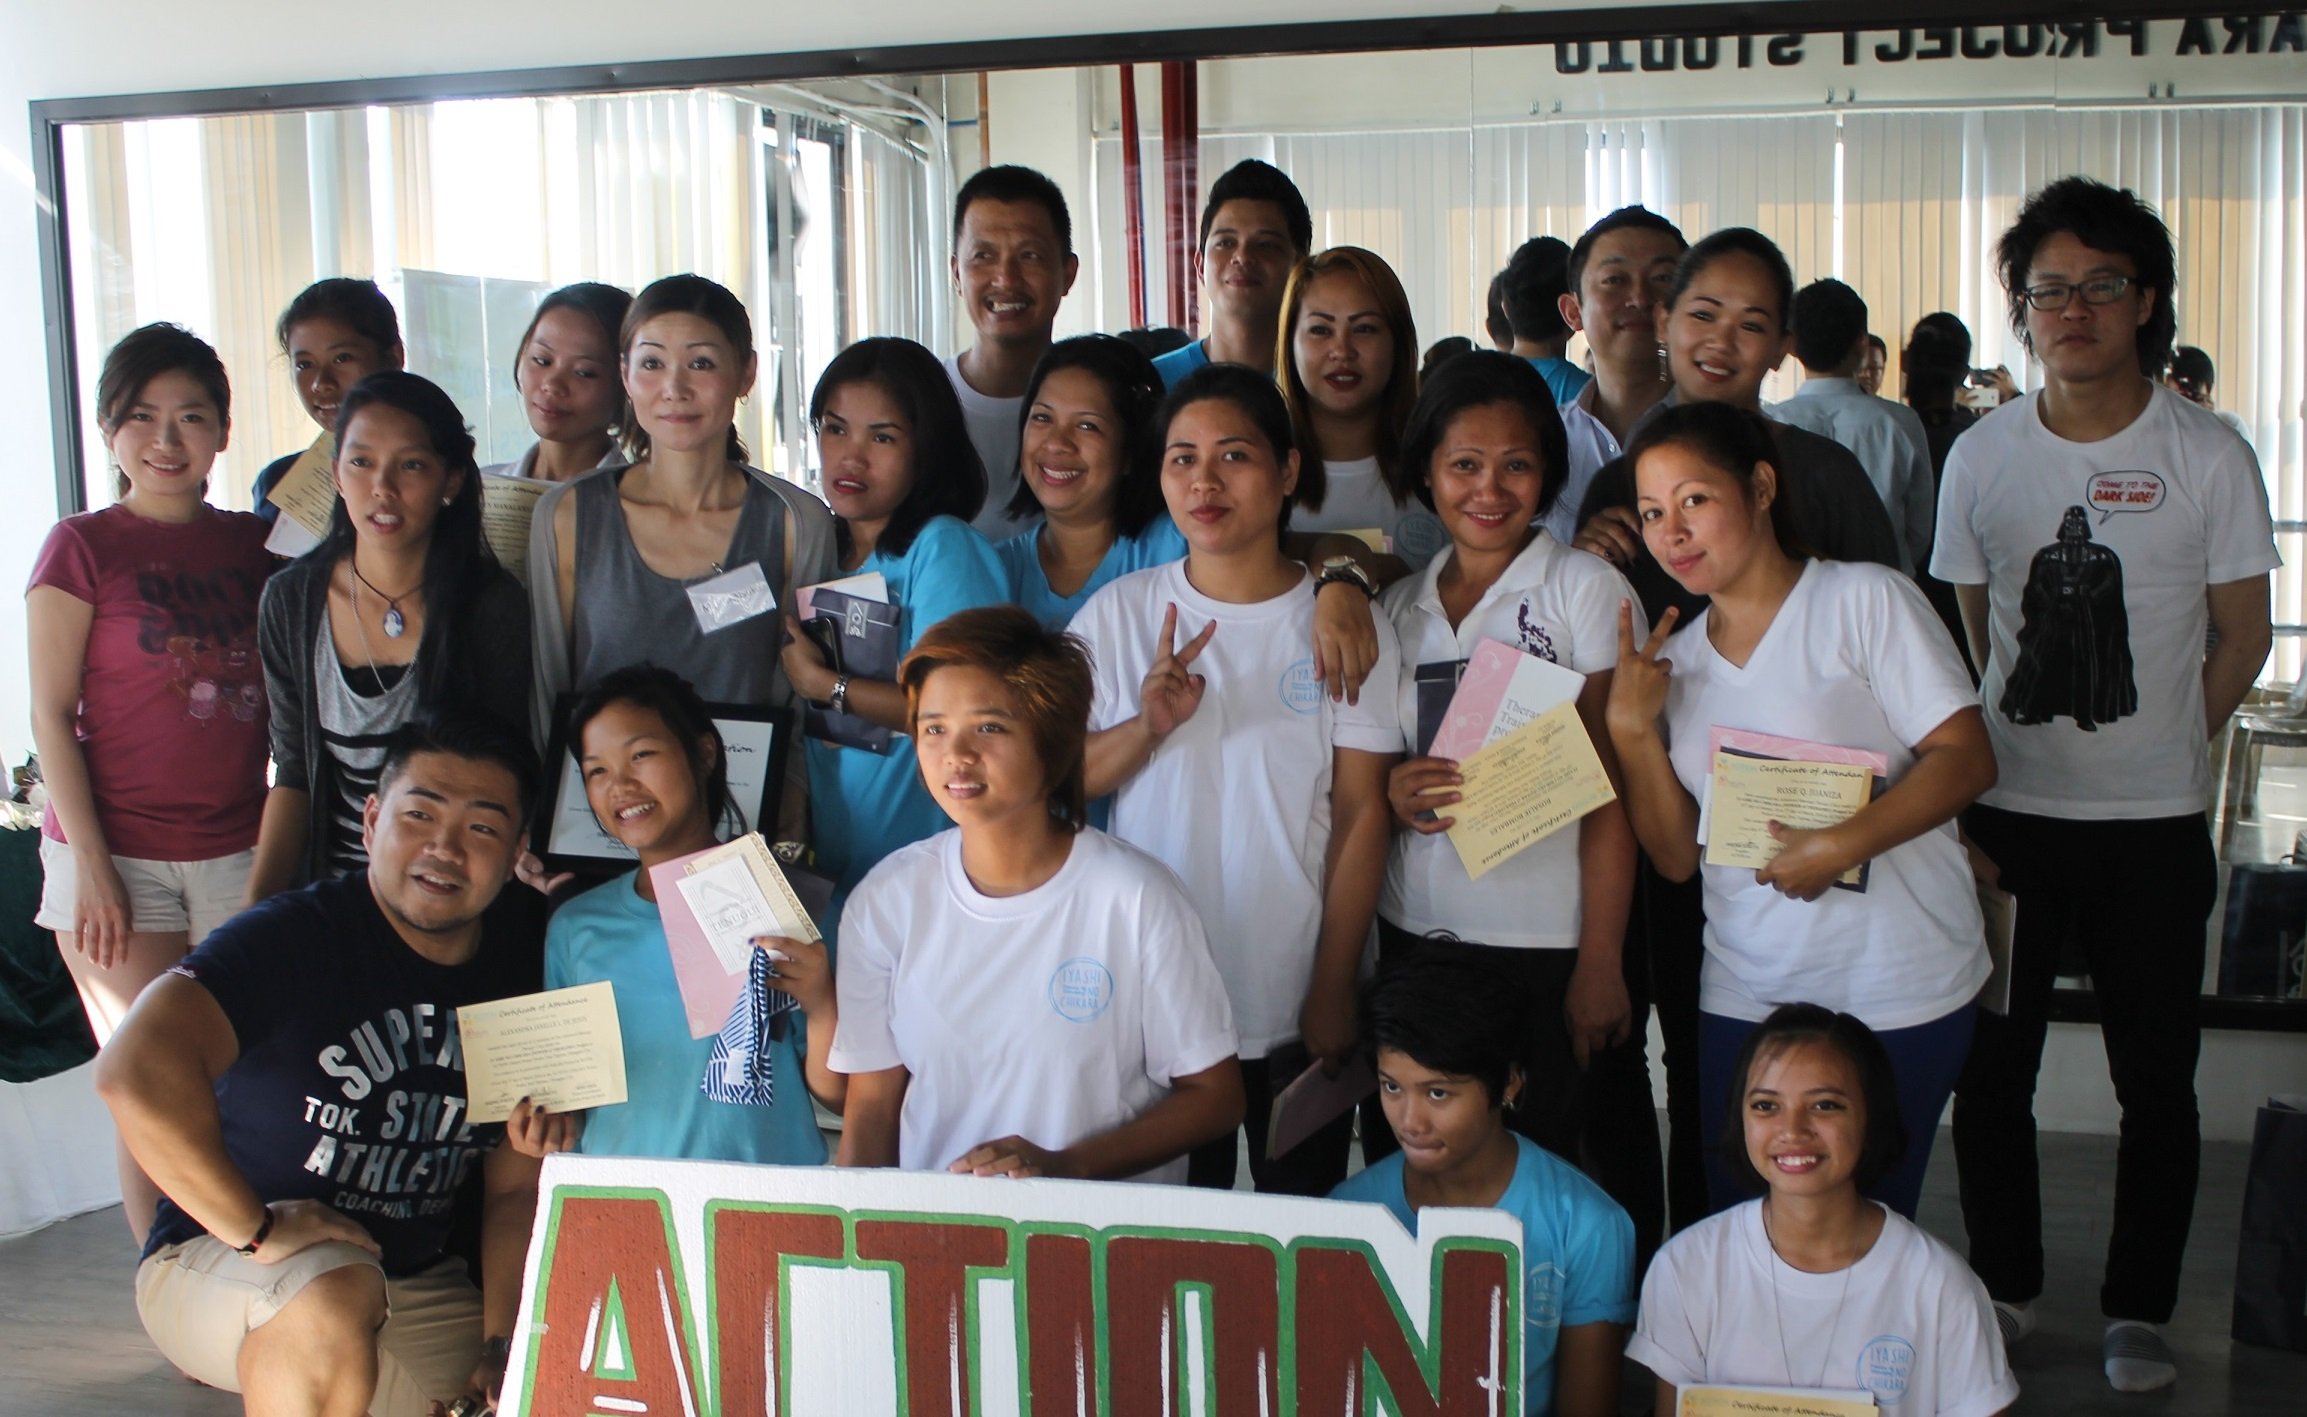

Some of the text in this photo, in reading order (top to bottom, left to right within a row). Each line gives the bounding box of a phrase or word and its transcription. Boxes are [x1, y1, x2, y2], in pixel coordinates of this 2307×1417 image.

[2094, 489, 2156, 503] DARK SIDE!
[1759, 765, 1807, 777] Certificate
[1810, 767, 1821, 777] of
[1062, 968, 1101, 984] IYASHI
[304, 1095, 361, 1136] TOK.
[520, 1185, 1520, 1417] ACTION
